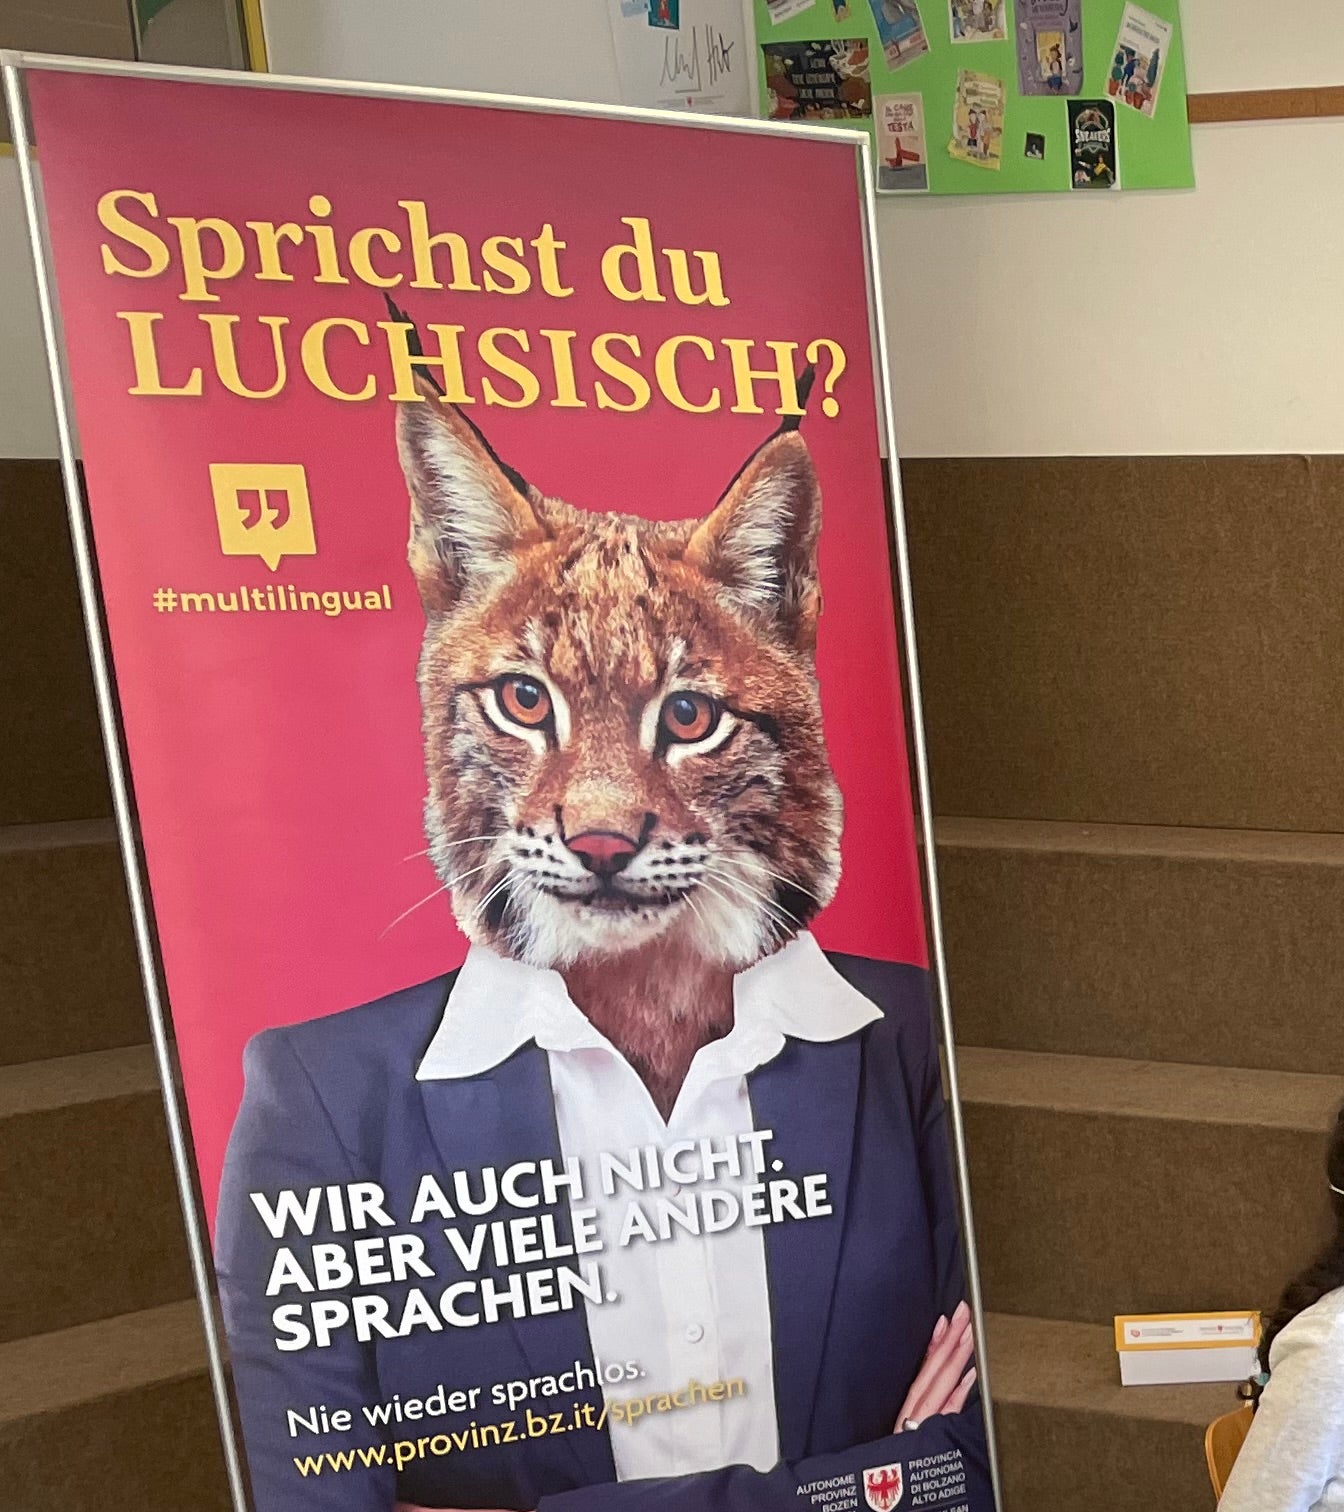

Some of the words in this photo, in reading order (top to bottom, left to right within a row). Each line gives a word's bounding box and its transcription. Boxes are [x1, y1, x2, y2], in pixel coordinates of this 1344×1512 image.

[97, 189, 577, 302] Sprichst
[601, 216, 731, 306] du
[115, 309, 849, 419] LUCHSISCH?
[151, 583, 393, 618] #multilingual
[251, 1182, 397, 1241] WIR
[410, 1155, 586, 1226] AUCH
[599, 1127, 785, 1198] NICHT.
[265, 1227, 436, 1298] ABER
[449, 1211, 607, 1276] VIELE
[618, 1173, 834, 1249] ANDERE
[274, 1261, 618, 1353] SPRACHEN.
[286, 1402, 356, 1440] Nie
[362, 1379, 483, 1428] wieder
[491, 1355, 647, 1413] sprachlos.
[293, 1373, 746, 1479] www.provinz.bz.it/sprachen
[796, 1473, 856, 1496] AUTONOME
[908, 1448, 963, 1471] PROVINCIA
[910, 1461, 964, 1483] AUTONOMA
[910, 1483, 922, 1494] DI
[922, 1472, 966, 1490] BOLZANO
[811, 1485, 857, 1505] PROVINZ
[911, 1490, 937, 1507] ALTO
[938, 1482, 967, 1500] ADIGE
